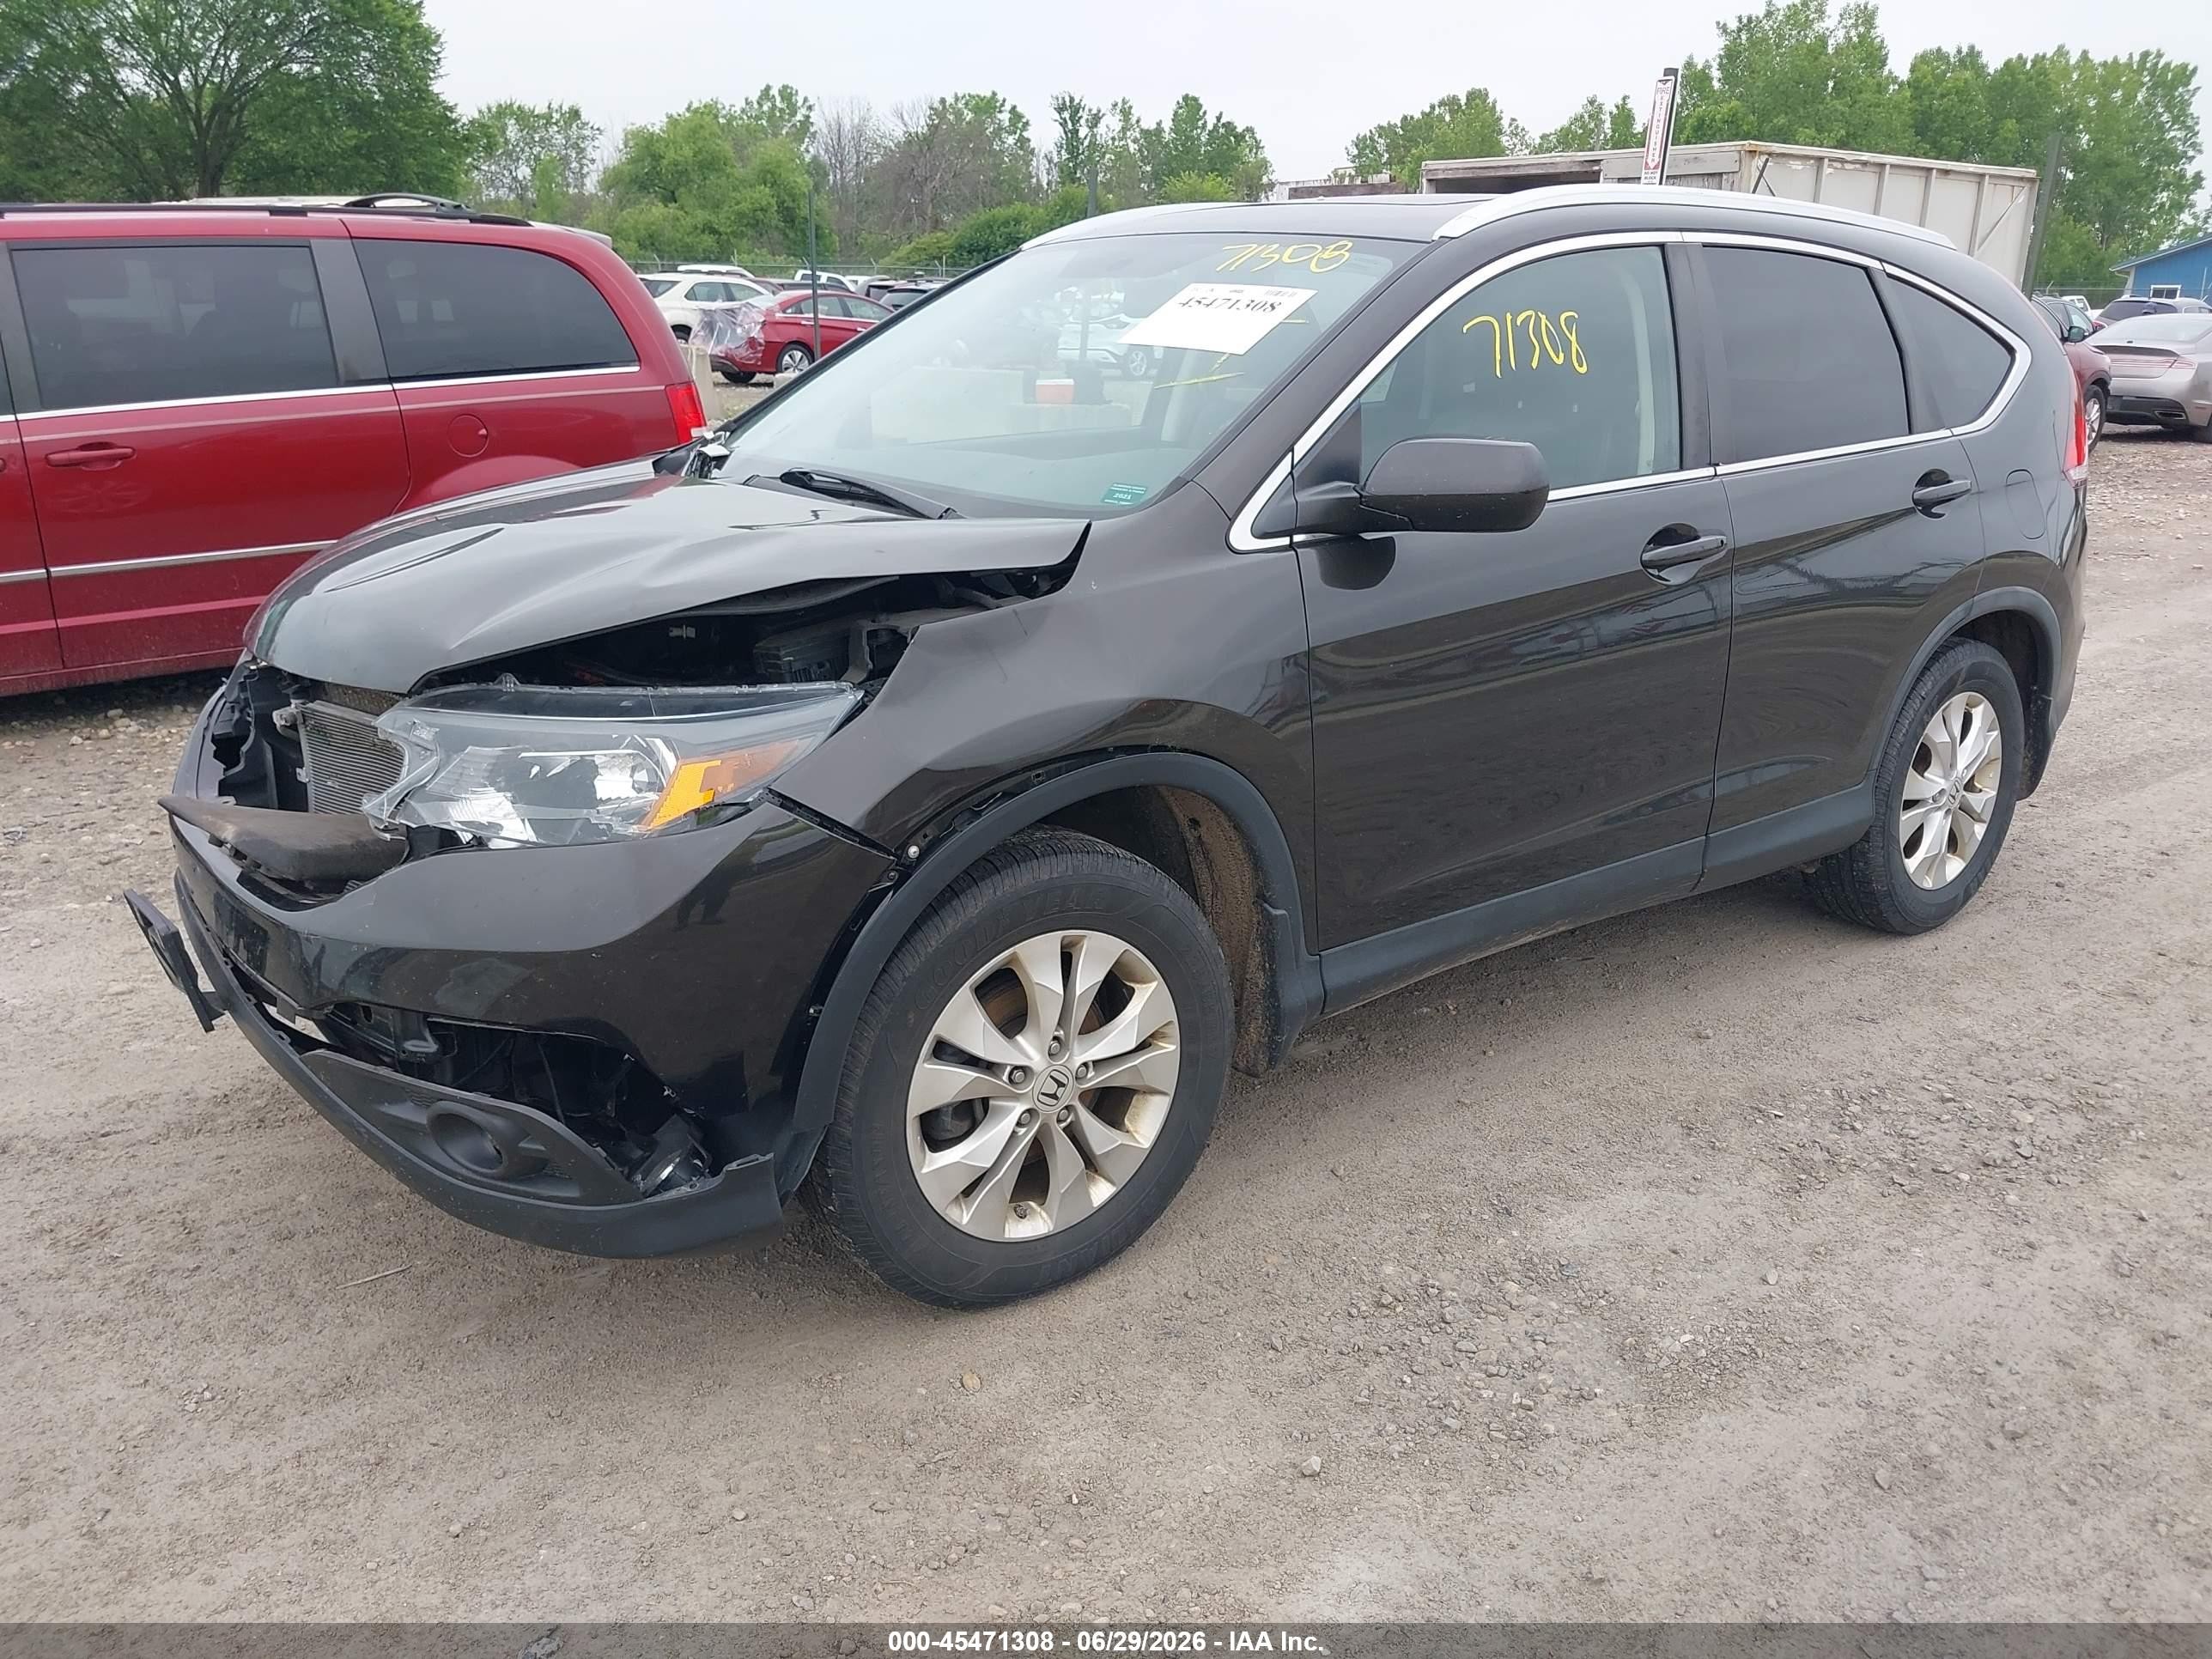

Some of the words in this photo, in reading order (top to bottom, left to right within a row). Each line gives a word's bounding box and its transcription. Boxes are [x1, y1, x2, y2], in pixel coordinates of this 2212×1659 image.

[1656, 86, 1670, 94] FIRE
[1177, 295, 1283, 313] 45471308
[1462, 309, 1589, 379] 71308
